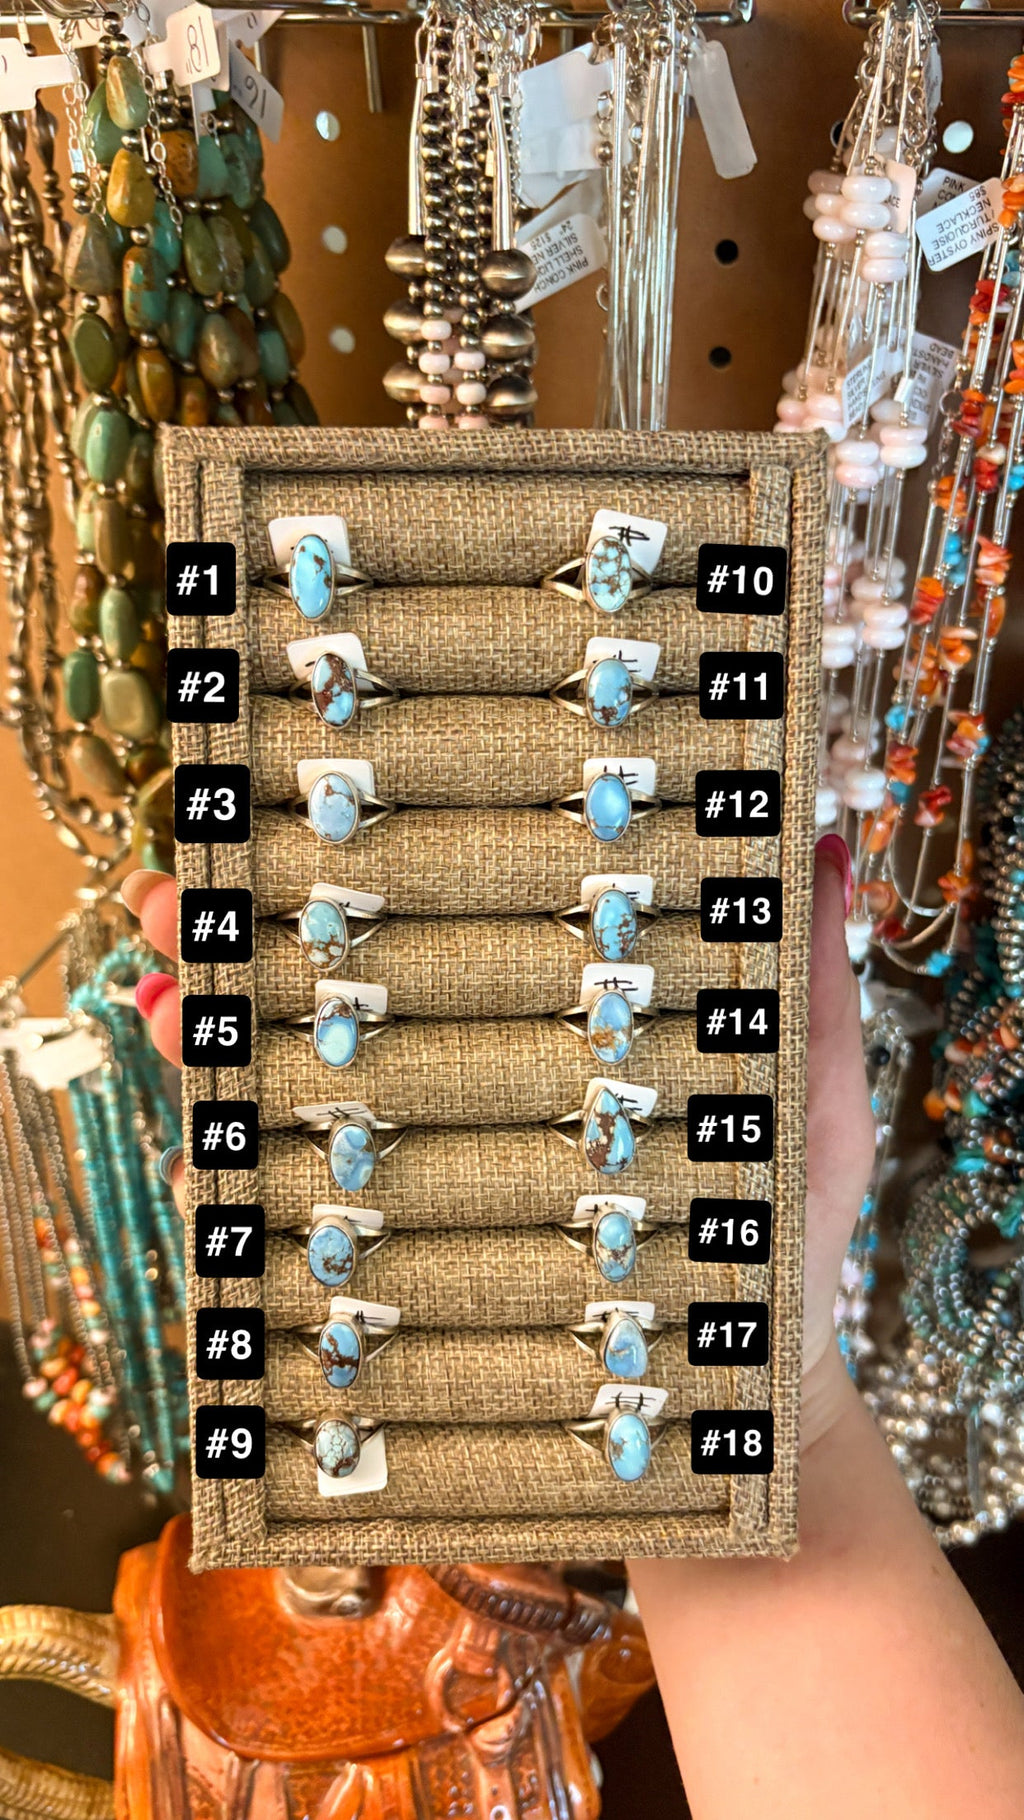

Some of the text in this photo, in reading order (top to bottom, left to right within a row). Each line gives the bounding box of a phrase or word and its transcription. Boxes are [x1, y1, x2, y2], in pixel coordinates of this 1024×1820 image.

[937, 189, 957, 201] CO
[942, 176, 967, 193] PINK
[968, 185, 988, 202] $85
[936, 198, 992, 233] NECKLACE
[530, 232, 552, 251] $125
[546, 232, 578, 256] SILVER
[927, 222, 1000, 267] SPINY OYSTER
[535, 245, 583, 278] SHELL LIQ
[534, 256, 589, 293] PINK CONCH
